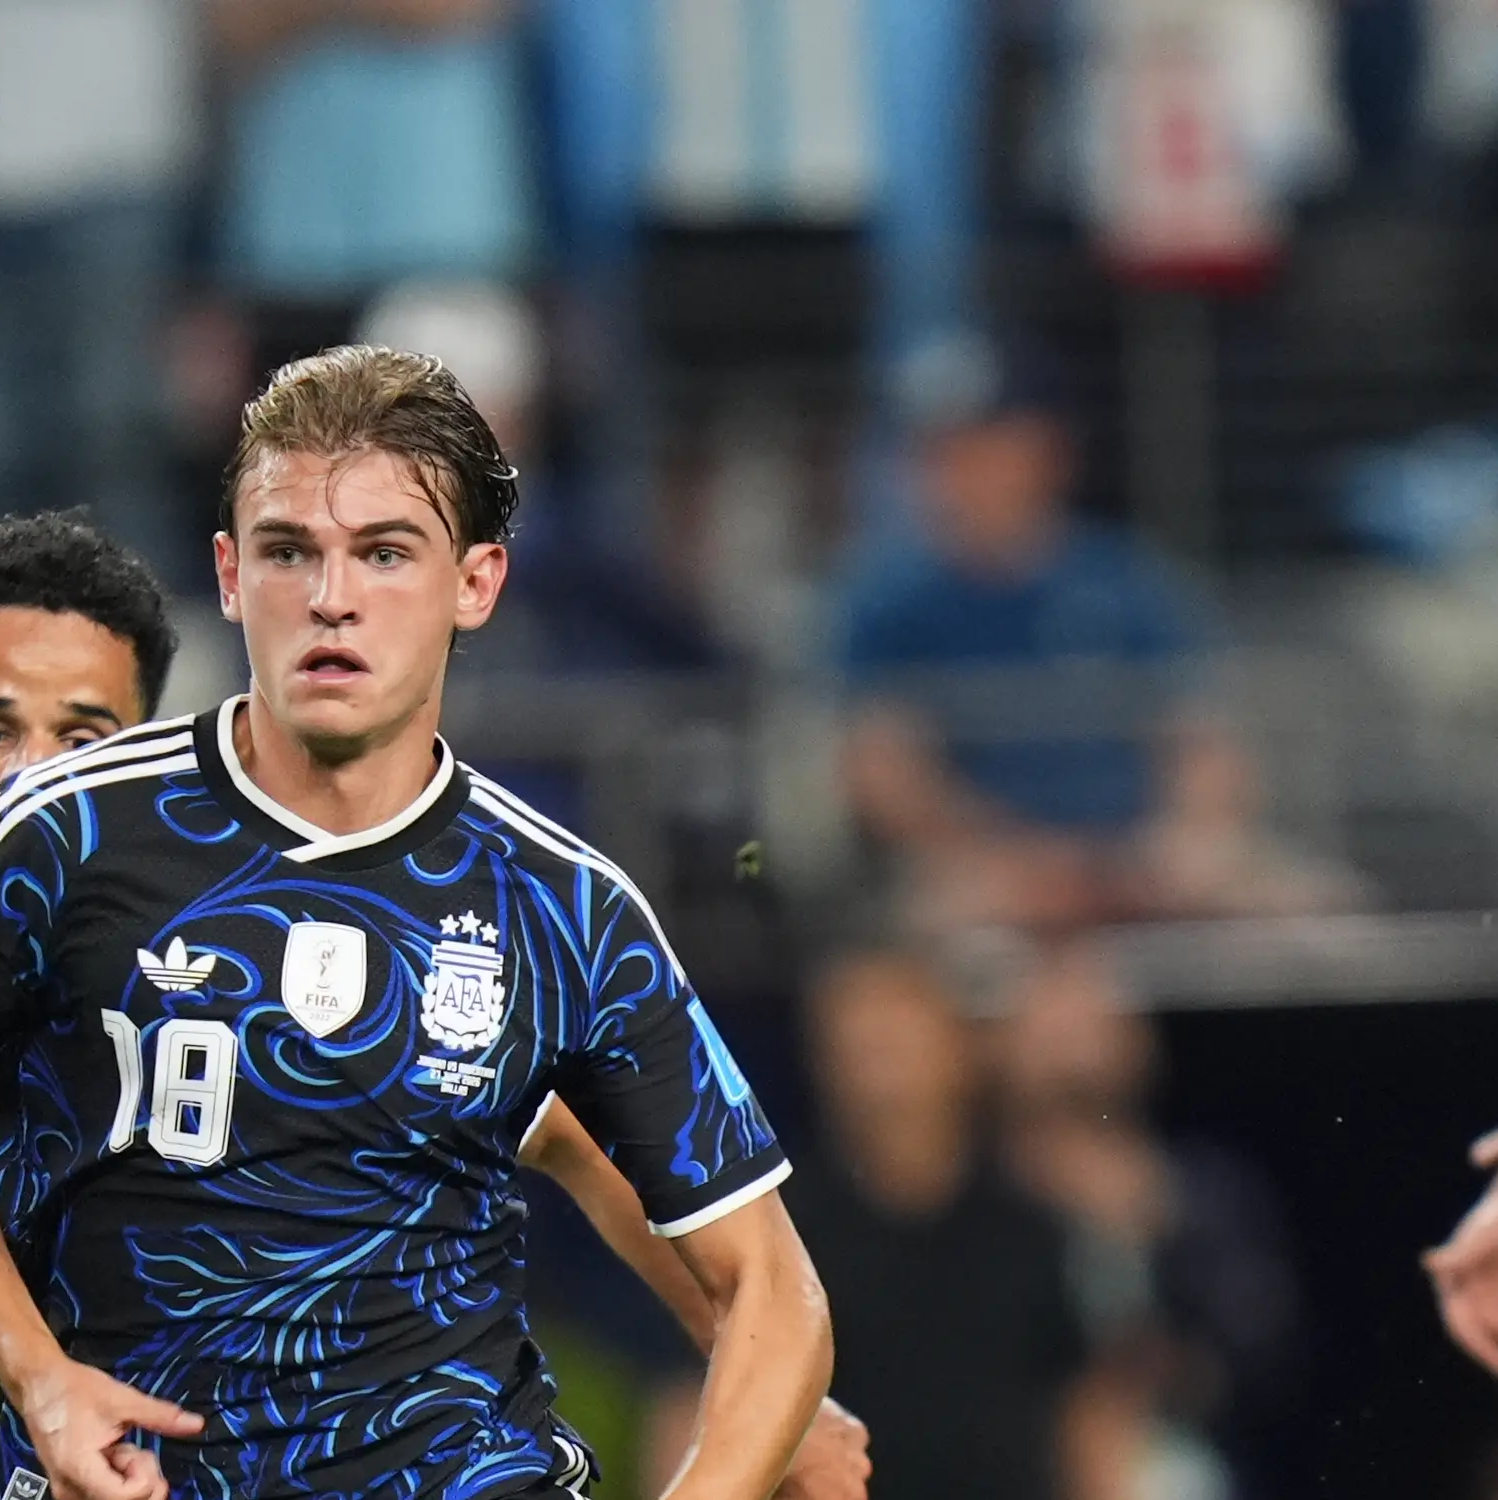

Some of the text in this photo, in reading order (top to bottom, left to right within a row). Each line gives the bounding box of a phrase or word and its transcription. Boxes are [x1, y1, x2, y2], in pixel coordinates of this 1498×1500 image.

[305, 993, 339, 1008] FIFA
[441, 970, 486, 1019] AFA
[101, 1008, 239, 1167] 18
